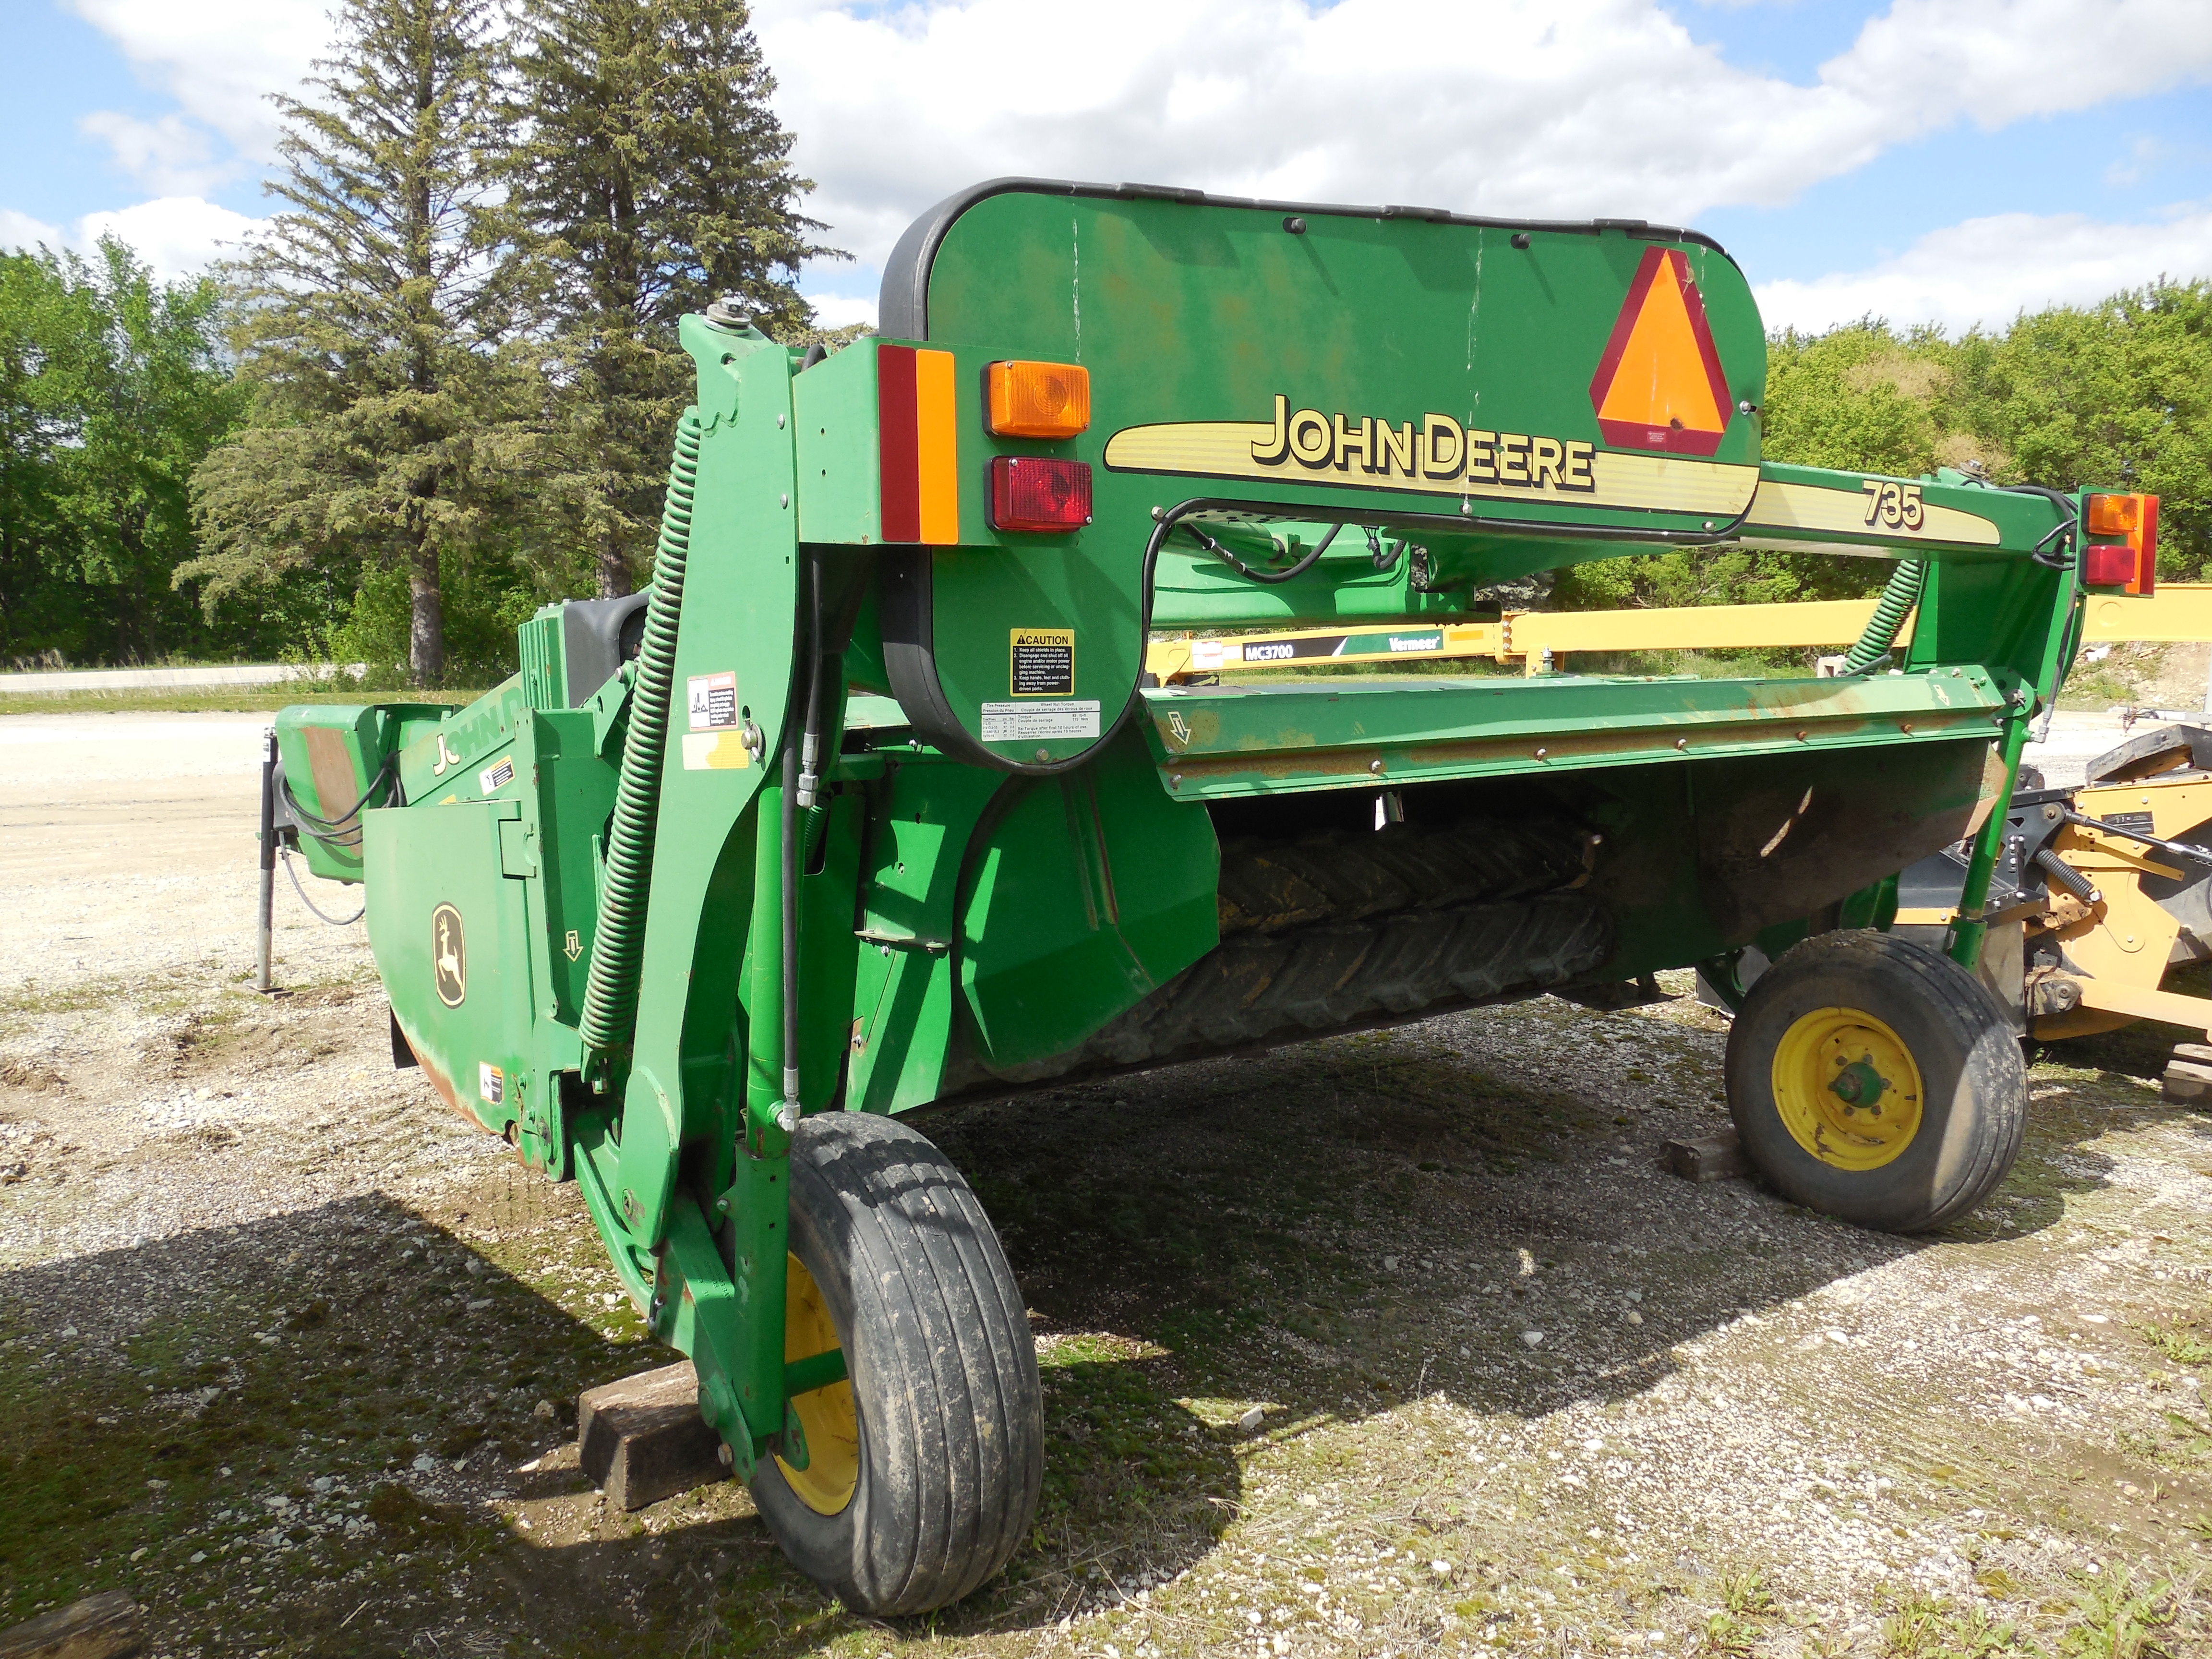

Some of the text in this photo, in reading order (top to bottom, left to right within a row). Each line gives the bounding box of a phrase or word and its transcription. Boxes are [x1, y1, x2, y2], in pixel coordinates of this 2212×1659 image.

[1250, 394, 1596, 493] JOHN DEERE
[1863, 479, 1924, 531] 735
[1026, 636, 1068, 645] CAUTION
[1389, 637, 1438, 651] Vermeer
[1246, 645, 1293, 661] MC3700
